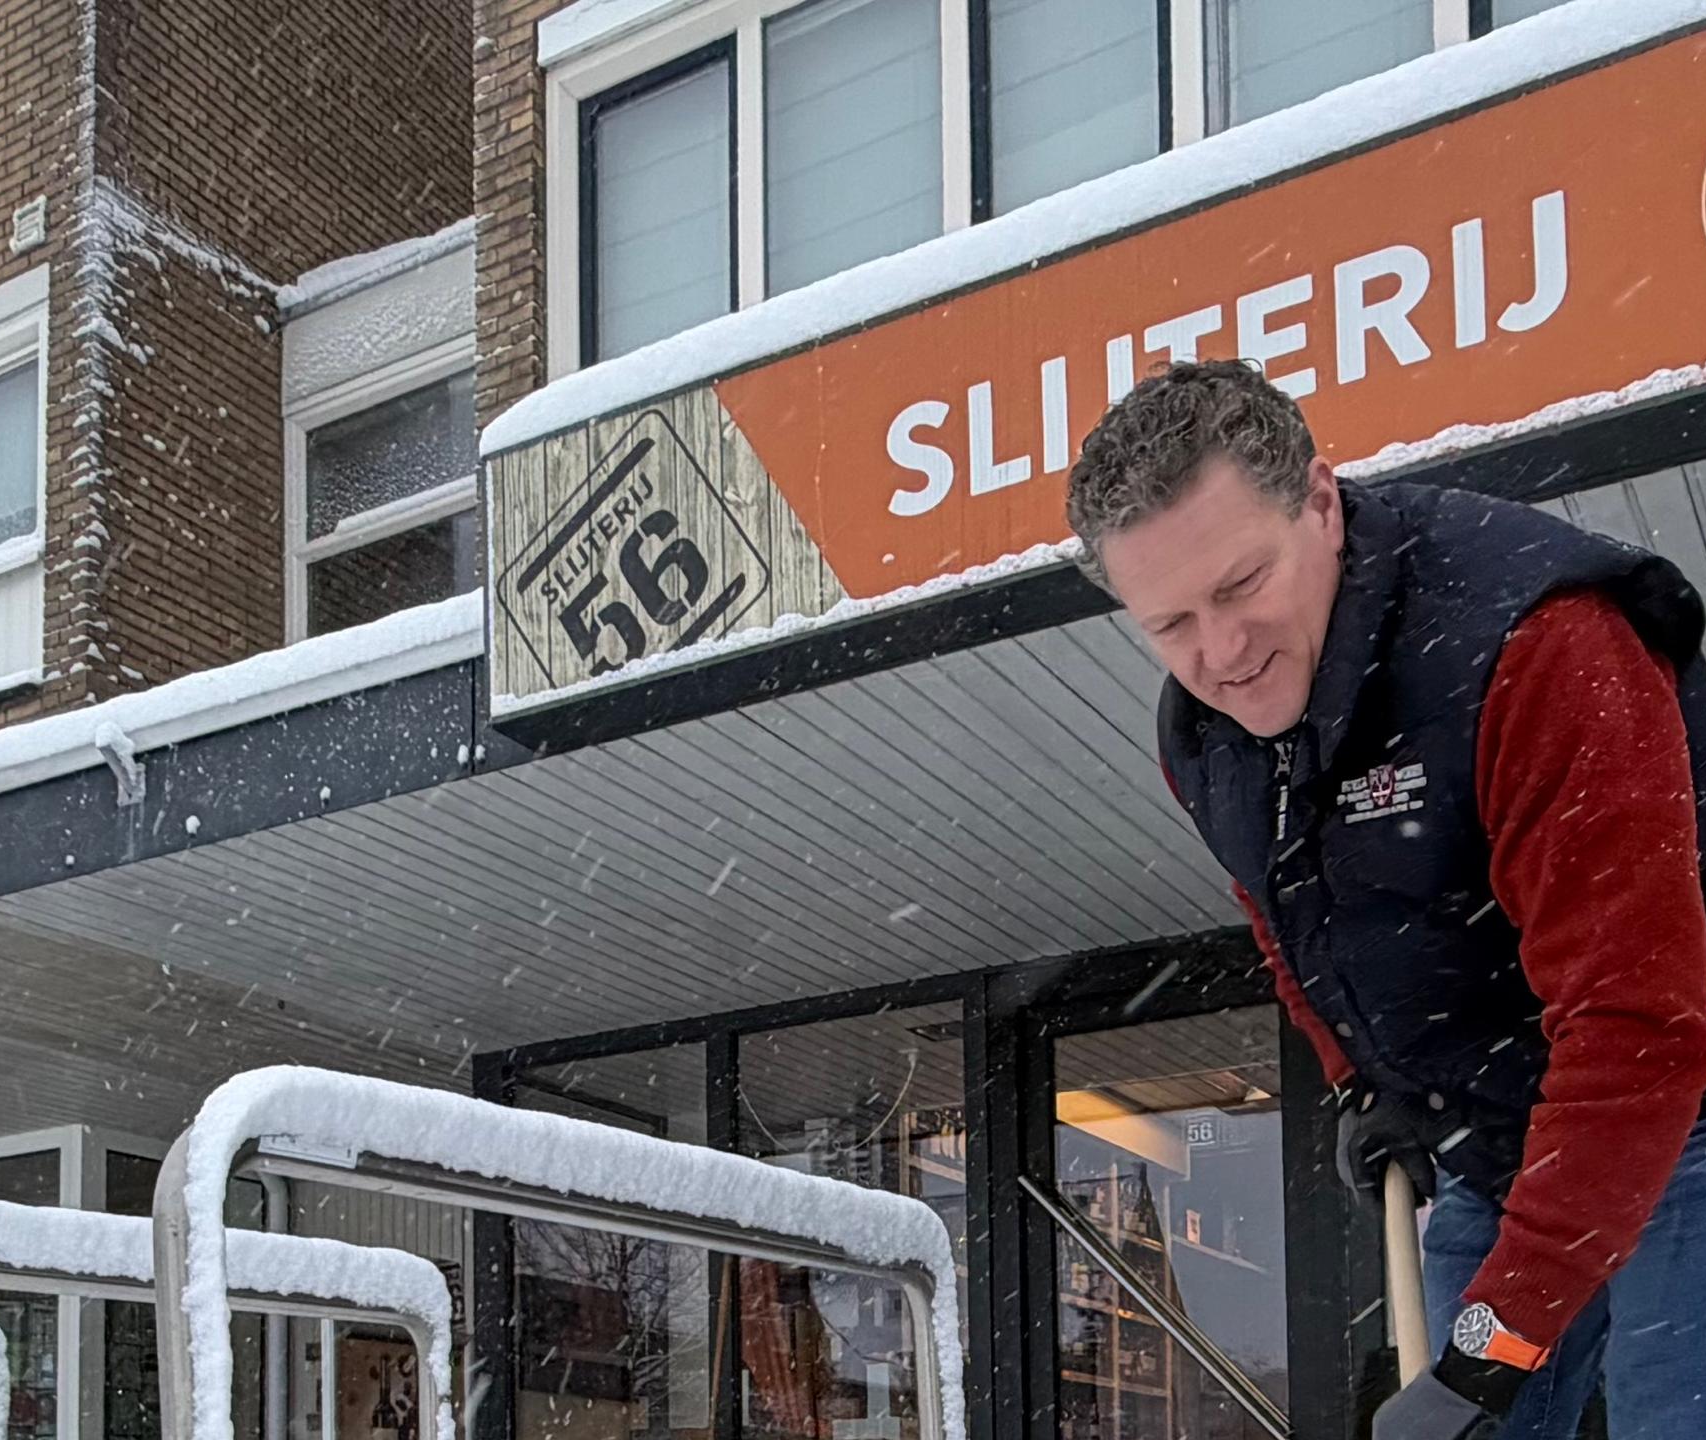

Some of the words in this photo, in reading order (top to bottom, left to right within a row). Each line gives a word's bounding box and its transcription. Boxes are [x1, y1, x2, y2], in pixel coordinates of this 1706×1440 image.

[540, 471, 655, 606] SLIJTERIJ
[558, 508, 709, 677] 56
[1188, 1122, 1213, 1142] 56
